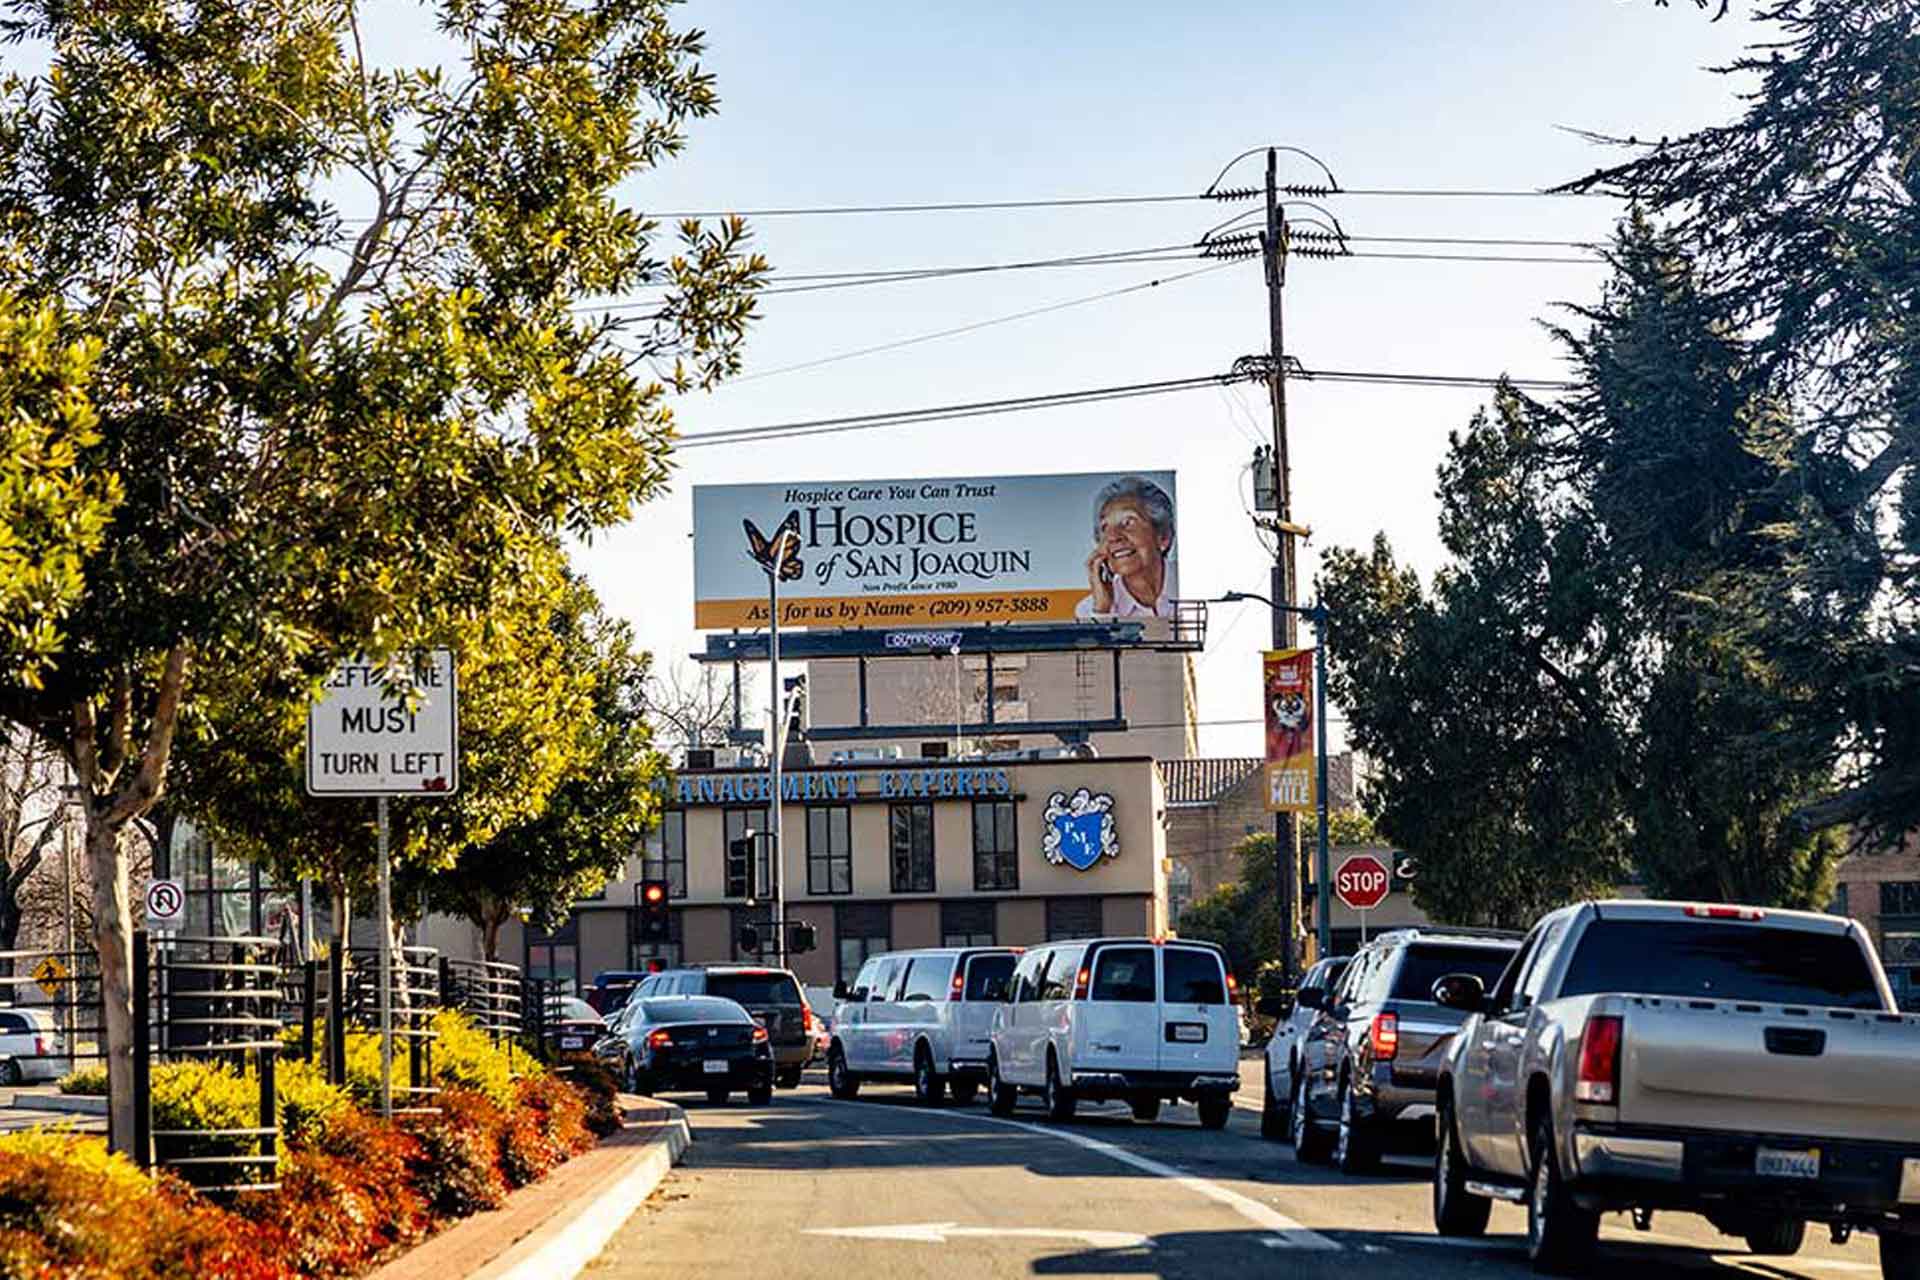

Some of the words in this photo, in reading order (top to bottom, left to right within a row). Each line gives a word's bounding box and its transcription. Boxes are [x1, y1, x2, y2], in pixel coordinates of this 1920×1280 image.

[785, 488, 843, 505] Hospice
[848, 486, 882, 501] Care
[889, 484, 916, 500] You
[920, 484, 950, 499] Can
[954, 483, 996, 498] Trust
[806, 505, 977, 548] HOSPICE
[815, 552, 842, 586] of
[846, 548, 902, 578] SAN
[910, 549, 1031, 583] JOAQUIN
[747, 603, 781, 620] As
[784, 602, 811, 622] for
[814, 603, 834, 618] us
[839, 601, 861, 621] by
[863, 600, 915, 617] Name
[929, 599, 972, 617] (209)
[974, 596, 1050, 613] 957-3888
[320, 665, 371, 687] EFT
[341, 706, 421, 734] MUST
[320, 752, 378, 774] TURN
[391, 752, 444, 774] LEFT
[879, 766, 1010, 799] EXPERTS
[1339, 872, 1385, 892] STOP
